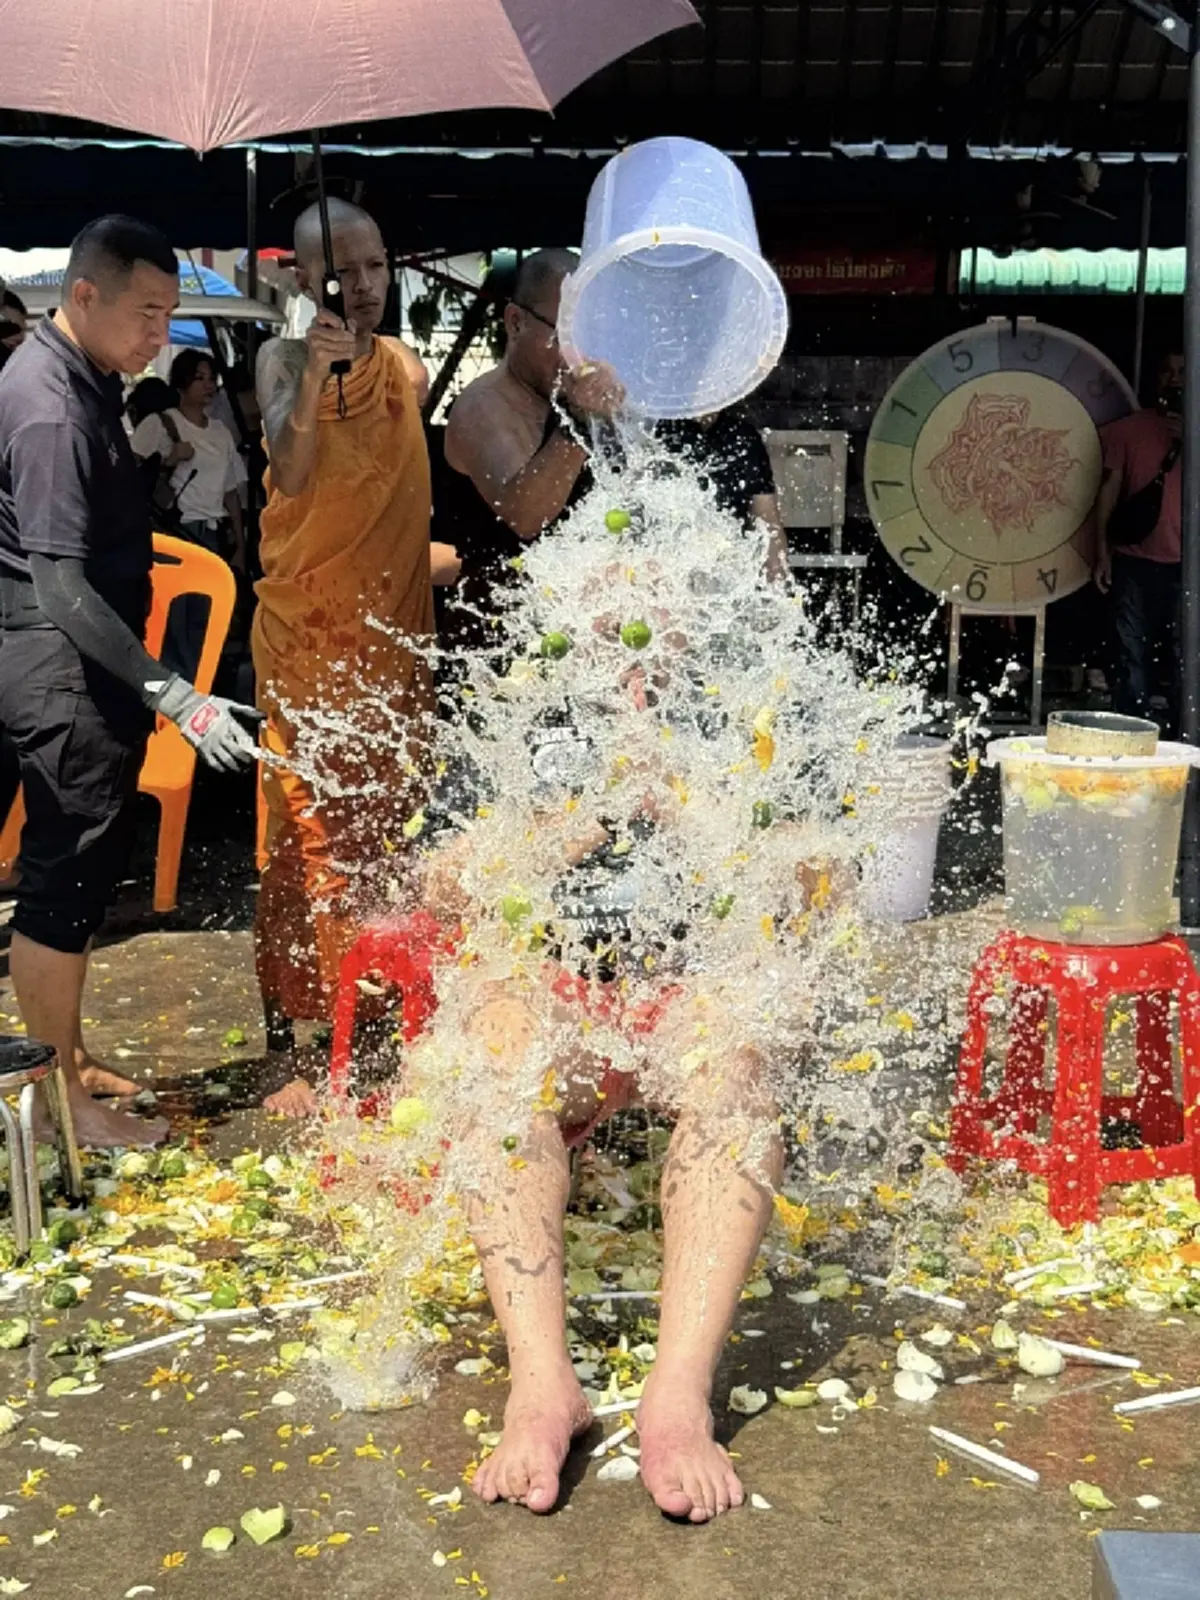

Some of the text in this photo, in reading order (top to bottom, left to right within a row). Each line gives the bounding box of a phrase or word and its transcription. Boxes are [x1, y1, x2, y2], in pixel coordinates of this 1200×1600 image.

[948, 339, 973, 373] 5
[1022, 334, 1046, 363] 3
[890, 399, 918, 418] 1
[872, 479, 904, 501] 7
[899, 535, 932, 567] 2
[1037, 568, 1058, 595] 4
